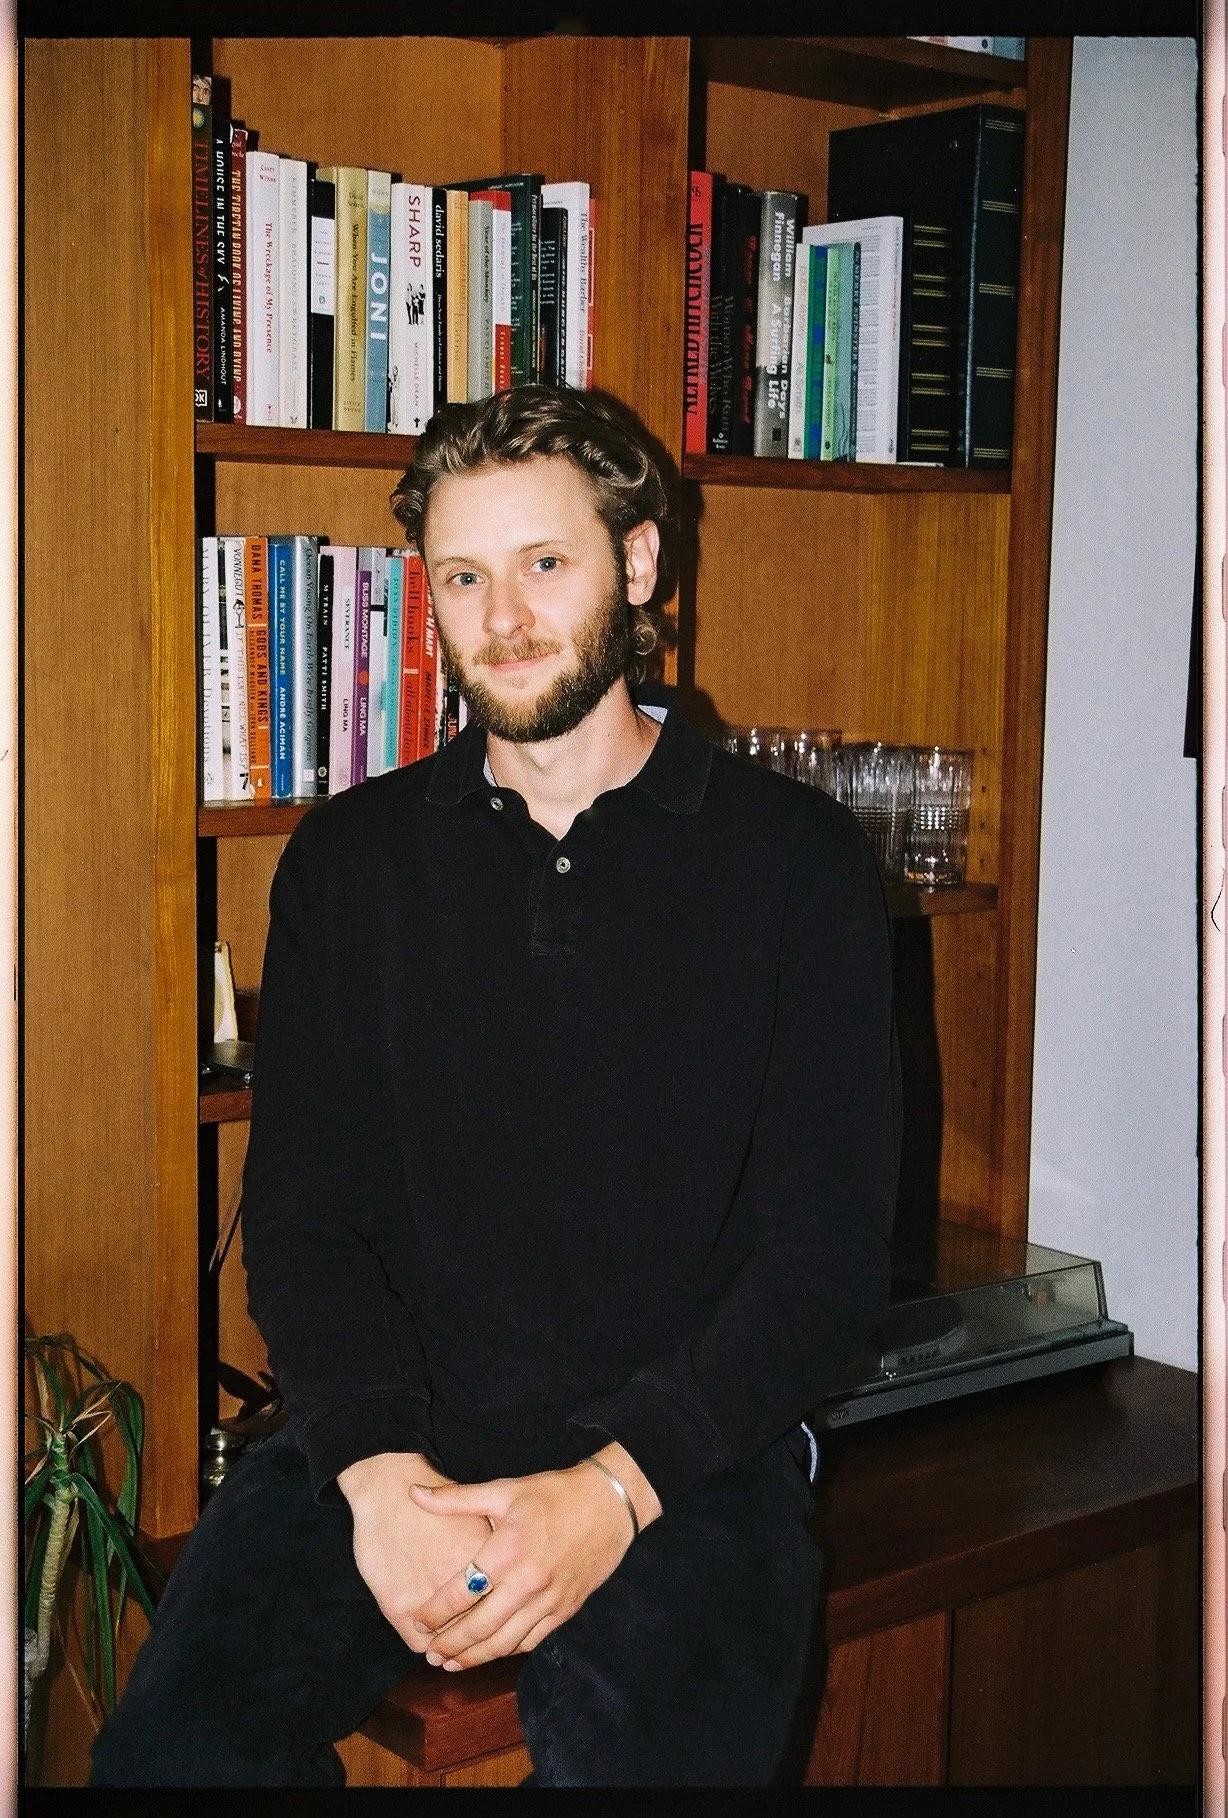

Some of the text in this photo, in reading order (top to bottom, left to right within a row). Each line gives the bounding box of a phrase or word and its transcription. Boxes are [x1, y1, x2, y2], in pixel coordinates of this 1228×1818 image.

[232, 170, 242, 192] THE
[216, 197, 225, 210] IN
[231, 195, 242, 240] TIBETAN
[216, 215, 225, 237] THE
[408, 195, 421, 268] SHARP
[435, 204, 445, 279] david sedaris
[195, 139, 210, 380] TIMELINES of HISTORY
[578, 213, 588, 313] The Wealthy Barber
[770, 211, 786, 282] Finnegan
[784, 218, 795, 277] William
[263, 223, 273, 353] The Wreckage of My Presence
[350, 223, 360, 382] When You Are Engulfed in Flames
[370, 252, 388, 341] JONI
[766, 303, 783, 409] A Surfing Life
[777, 295, 793, 419] Barbarian Days
[233, 548, 245, 597] VONNEGUT
[305, 548, 314, 580] Ocean
[251, 544, 263, 620] DANA THOMAS
[279, 586, 286, 600] ME
[303, 581, 314, 613] Vuong
[279, 602, 286, 613] BY
[305, 615, 314, 630] On
[407, 570, 421, 654] bell hooks
[425, 617, 435, 628] H
[306, 632, 314, 660] Earth
[361, 608, 369, 659] MONTAGE
[425, 628, 435, 658] MART
[237, 648, 245, 672] THIS
[256, 630, 268, 723] GODS AND KINGS
[279, 687, 288, 719] ANDRÉ
[320, 679, 328, 710] SMITH
[405, 681, 417, 699] all
[423, 672, 432, 714] MICHELLE
[238, 701, 247, 721] NICE
[342, 719, 349, 732] MA
[405, 701, 416, 736] about
[239, 723, 248, 748] WHAT
[359, 720, 367, 736] MA
